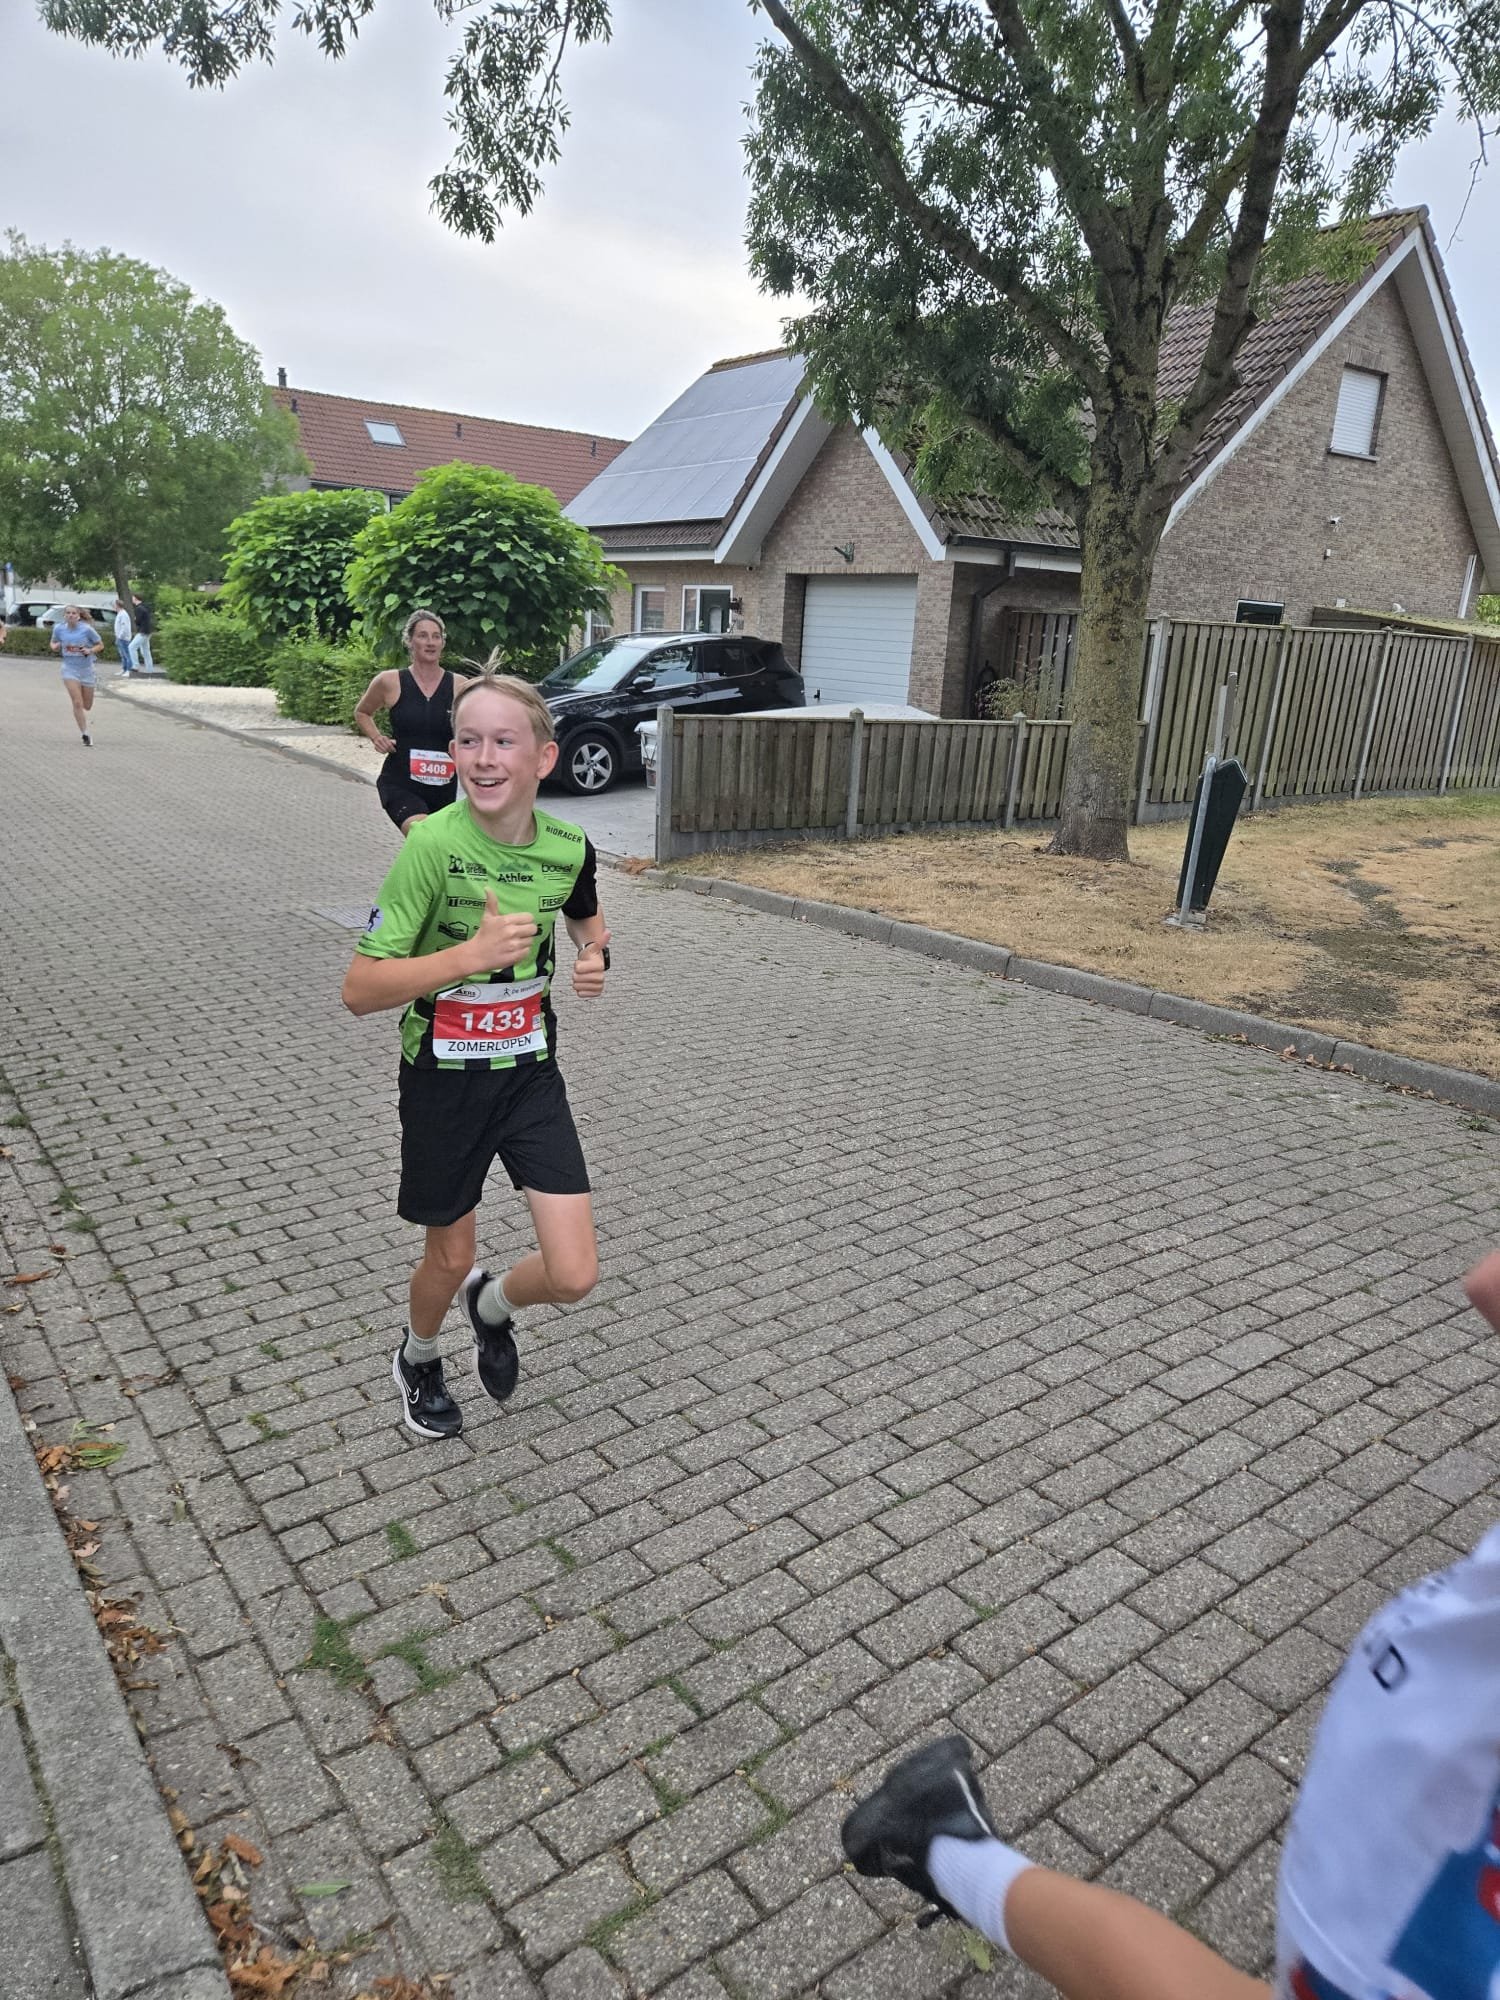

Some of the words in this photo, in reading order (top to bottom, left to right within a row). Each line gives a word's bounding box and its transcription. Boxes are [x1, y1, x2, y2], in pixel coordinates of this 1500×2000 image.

[419, 762, 447, 775] 3408
[545, 825, 583, 844] BIORACER
[497, 872, 534, 883] Athlex
[461, 1006, 526, 1032] 1433
[448, 1035, 532, 1052] ZOMERLOPEN
